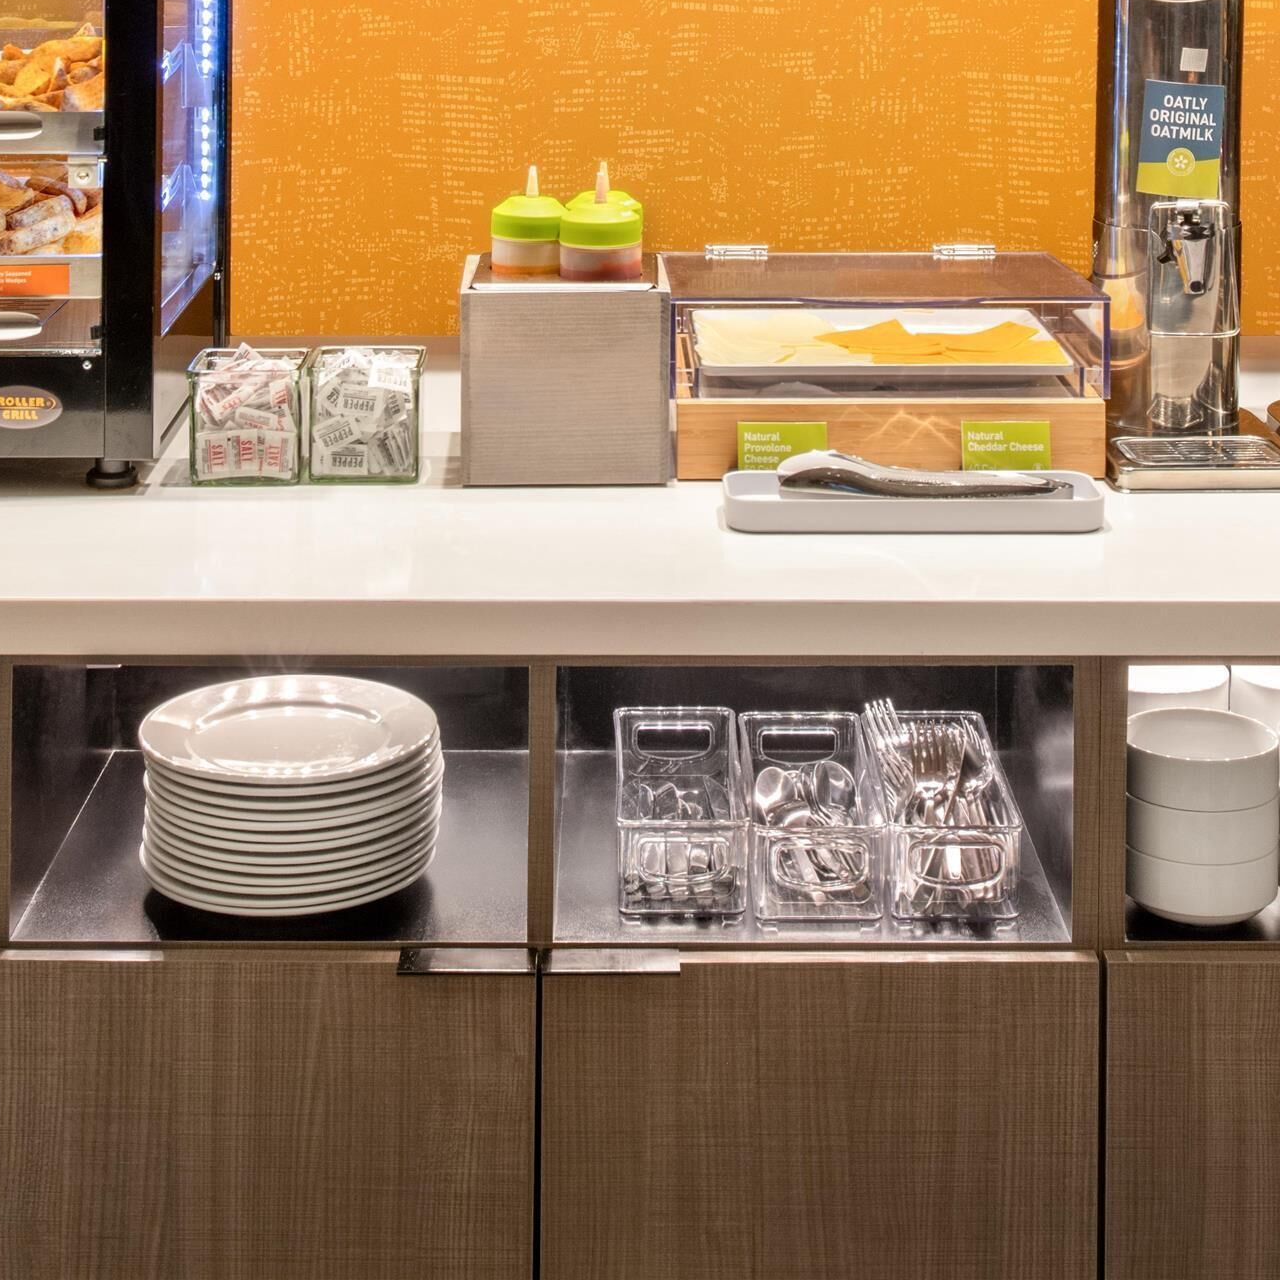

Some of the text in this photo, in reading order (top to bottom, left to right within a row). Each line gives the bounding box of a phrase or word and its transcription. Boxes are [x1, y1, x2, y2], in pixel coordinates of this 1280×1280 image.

[1163, 94, 1208, 110] OATLY
[1149, 108, 1217, 127] ORIGINAL
[1150, 123, 1214, 142] OATMILK
[343, 398, 376, 412] PEPPER
[2, 410, 39, 420] GRILL
[322, 426, 354, 448] PEPPER
[743, 431, 781, 441] Natural
[967, 431, 1004, 440] Natural
[240, 440, 254, 461] SALT
[743, 442, 792, 453] Provolone
[967, 441, 1044, 452] Cheddar Cheese
[211, 444, 225, 466] SALT
[267, 445, 281, 467] SALT
[331, 456, 364, 468] PEPPER
[744, 454, 780, 464] Cheese
